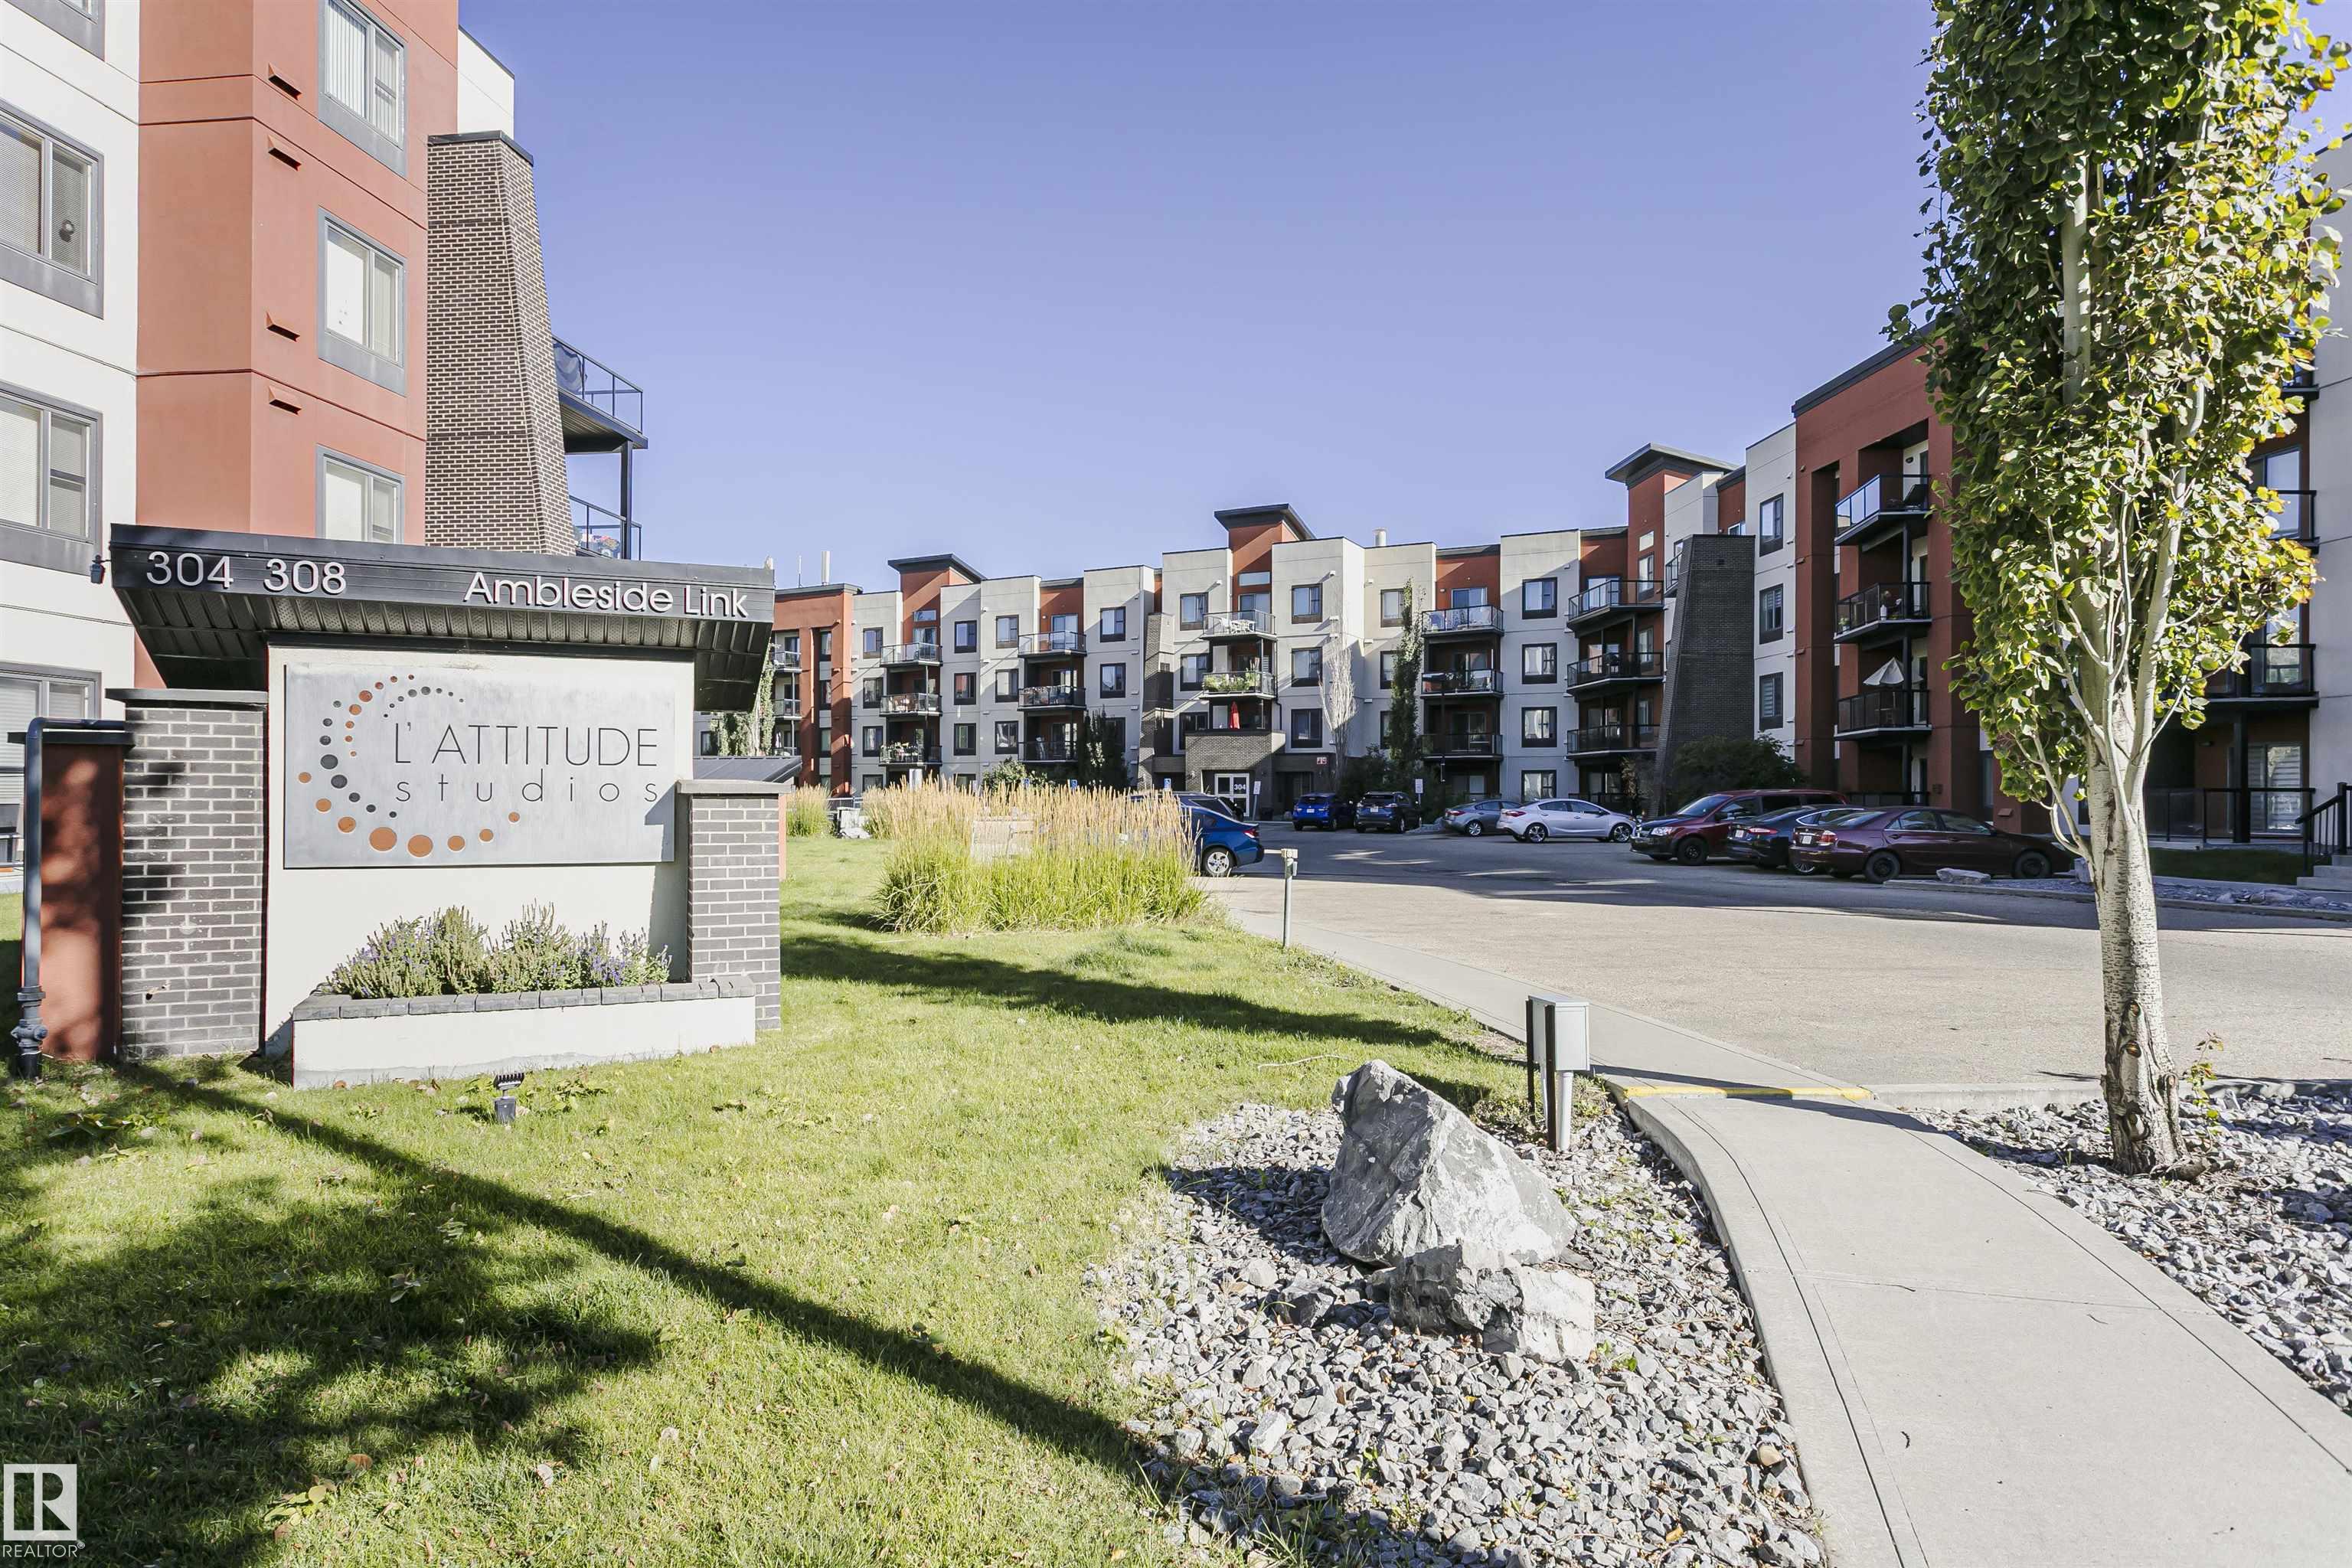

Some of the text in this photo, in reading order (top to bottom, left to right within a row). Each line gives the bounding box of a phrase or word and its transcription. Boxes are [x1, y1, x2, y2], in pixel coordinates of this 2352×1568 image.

[146, 551, 347, 595] 304 308
[462, 571, 749, 618] Ambleside Link
[395, 768, 658, 802] studios
